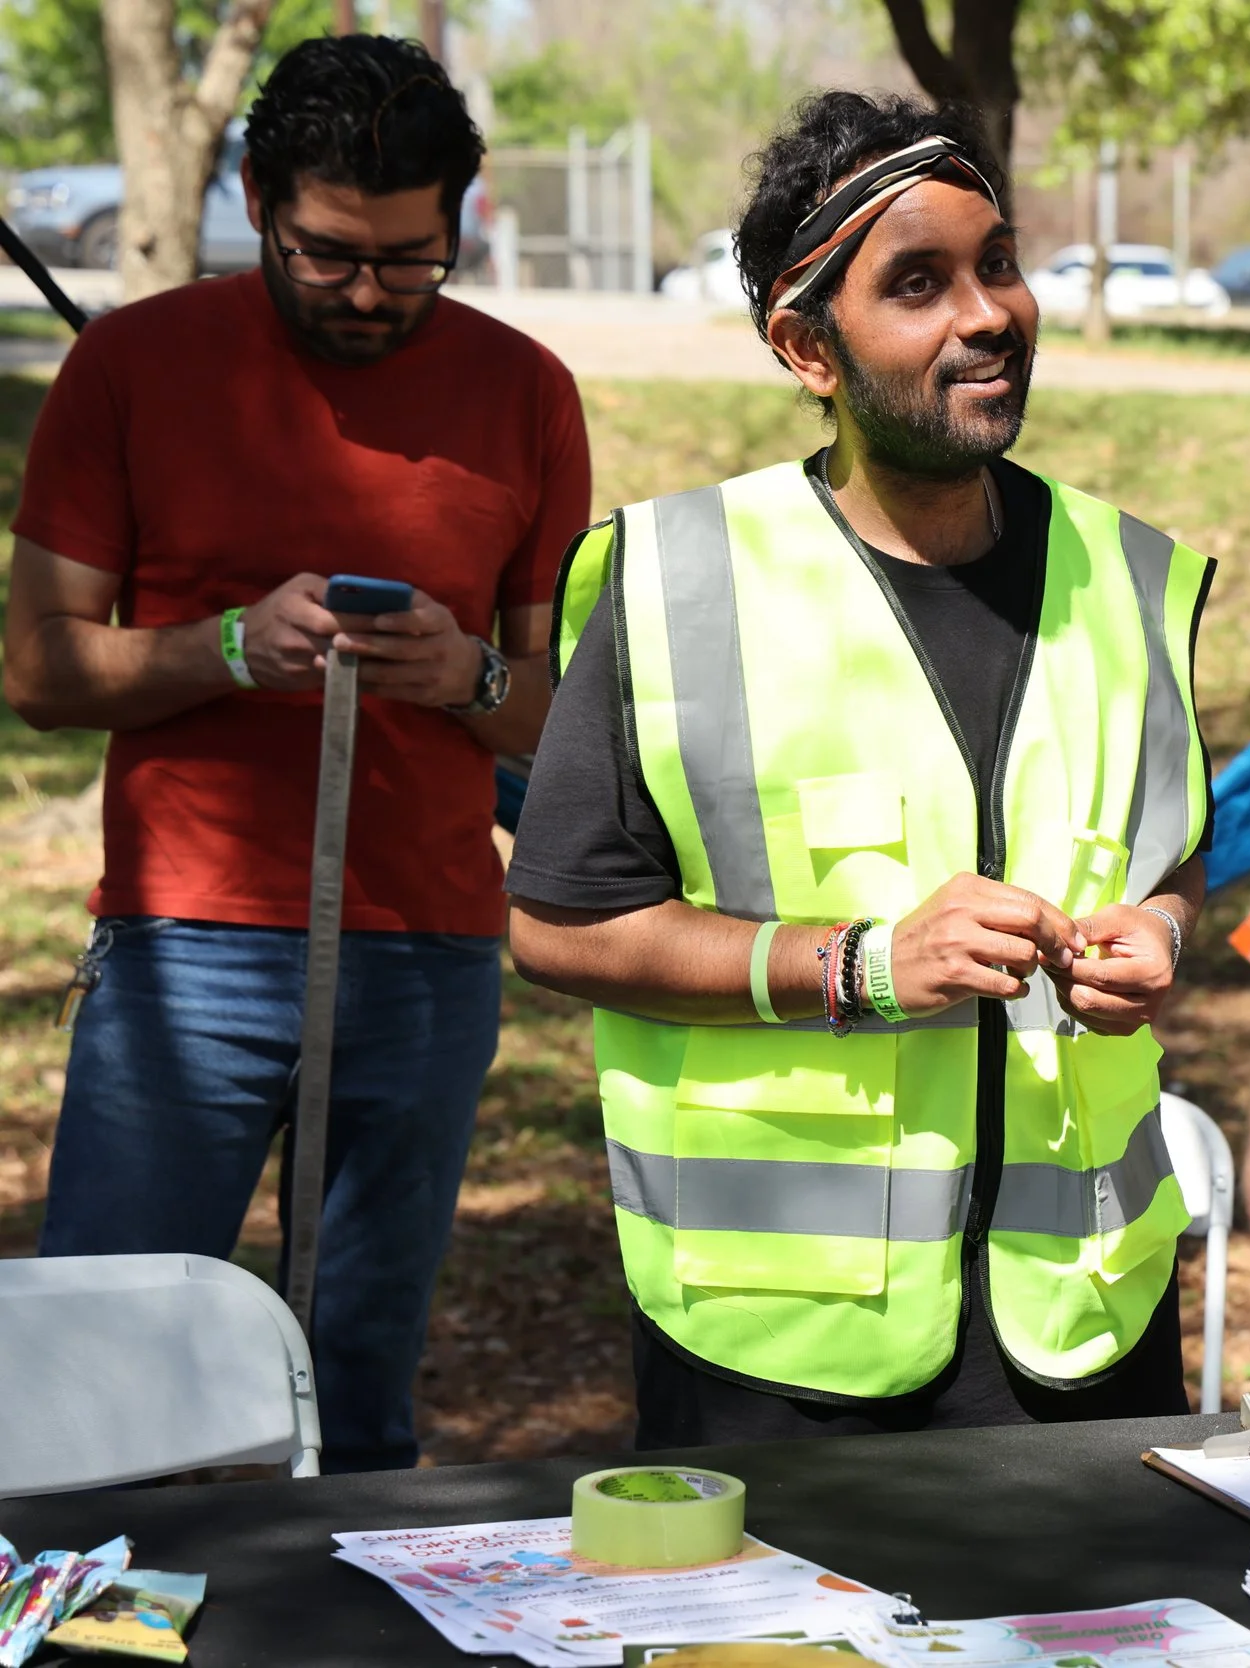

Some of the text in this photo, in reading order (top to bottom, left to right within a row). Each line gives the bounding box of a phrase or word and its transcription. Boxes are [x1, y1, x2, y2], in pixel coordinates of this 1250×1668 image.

[869, 946, 890, 1001] FUTURE
[398, 1536, 490, 1551] Taking
[492, 1530, 551, 1539] Care
[411, 1548, 455, 1557] Our
[492, 1587, 588, 1602] Workshop
[590, 1579, 650, 1590] Series
[651, 1568, 739, 1583] Schedule
[1031, 1619, 1173, 1643] ENVIRONMENTAL
